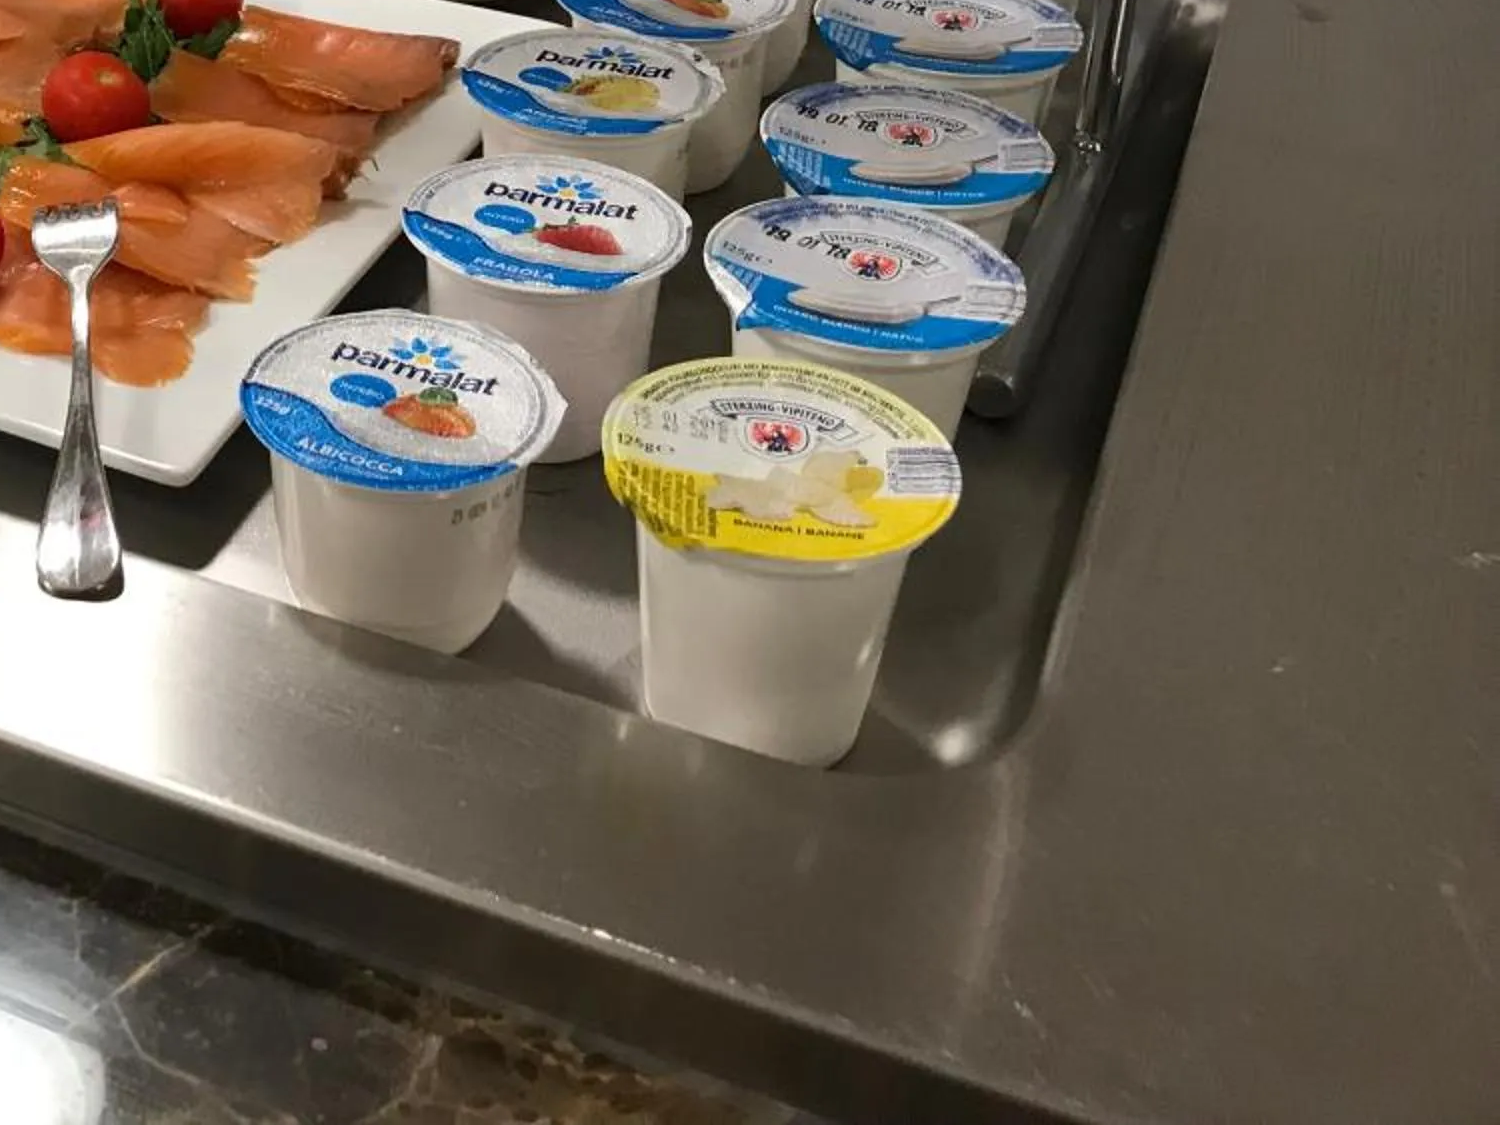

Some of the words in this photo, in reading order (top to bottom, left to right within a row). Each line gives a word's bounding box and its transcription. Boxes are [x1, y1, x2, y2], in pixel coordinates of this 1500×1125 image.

[536, 49, 675, 80] parmalat
[484, 181, 640, 221] parmalat
[473, 255, 555, 281] FRAGOLA
[330, 341, 501, 396] parmalat
[297, 436, 404, 476] ALBICOCCA
[733, 517, 794, 535] BANANA
[805, 527, 866, 541] BANANE
